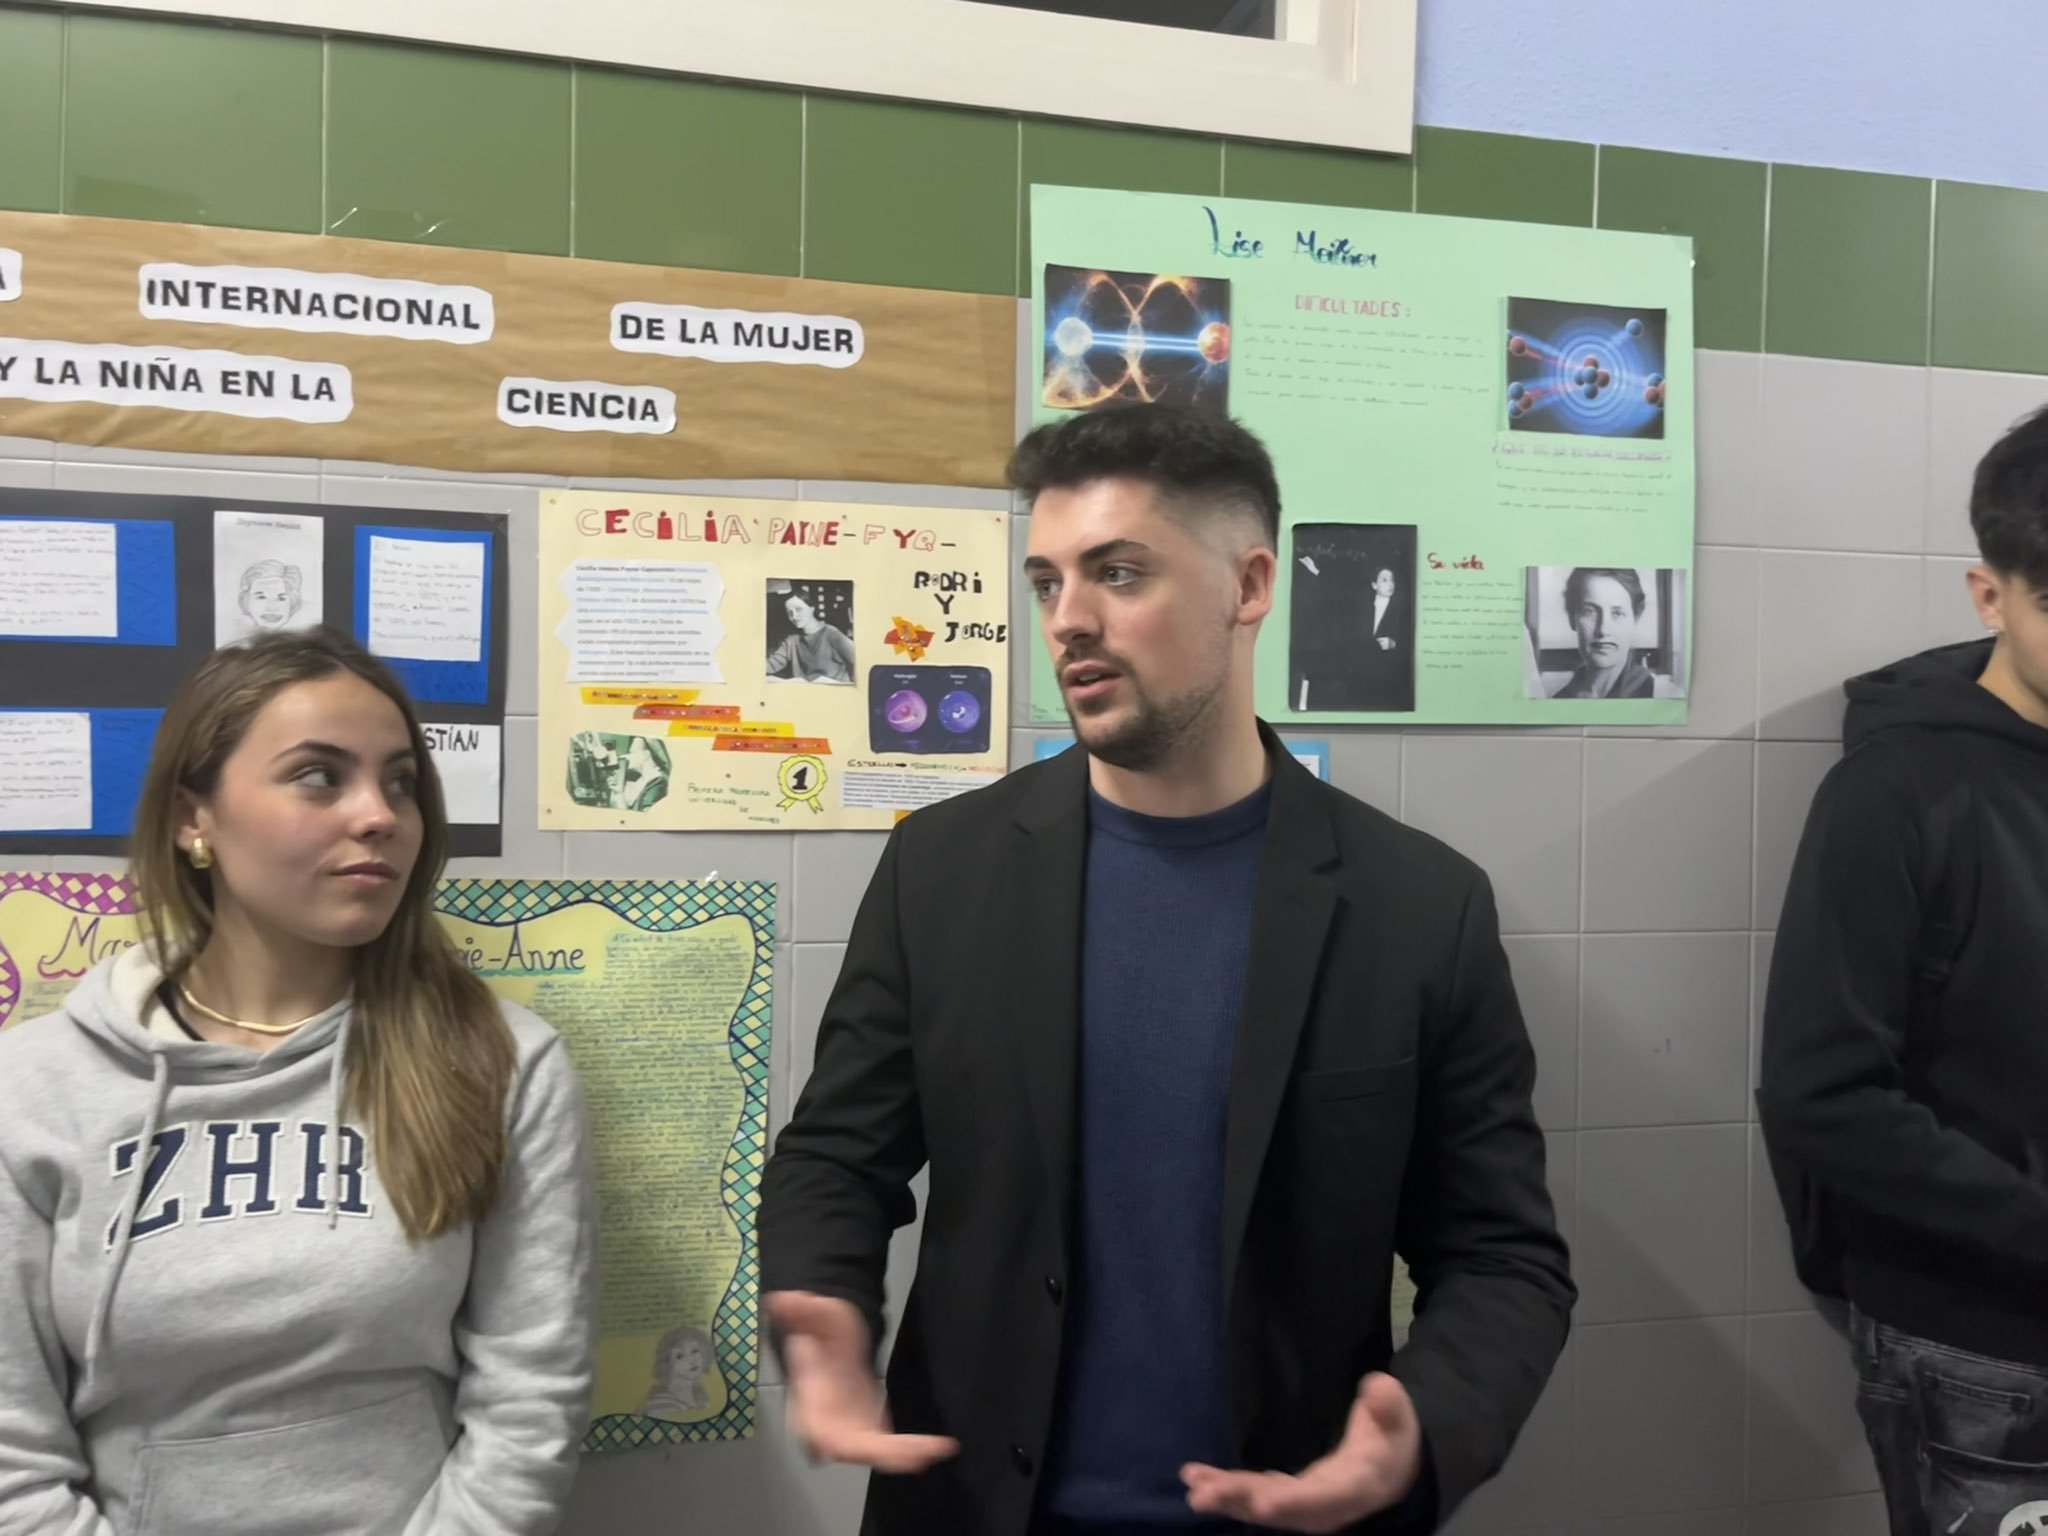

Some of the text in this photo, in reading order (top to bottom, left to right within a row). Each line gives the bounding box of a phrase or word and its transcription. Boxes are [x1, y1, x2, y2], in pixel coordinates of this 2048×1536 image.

[1202, 206, 1264, 258] Lise
[146, 278, 854, 354] INTERNACIONAL DE LA MUJER
[0, 356, 660, 422] Y LA NIÑA EN LA CIENCIA
[934, 593, 955, 615] Y
[945, 622, 1007, 643] JORGE
[424, 725, 479, 751] STÍAN
[793, 766, 808, 791] 1
[103, 1119, 374, 1255] ZHR
